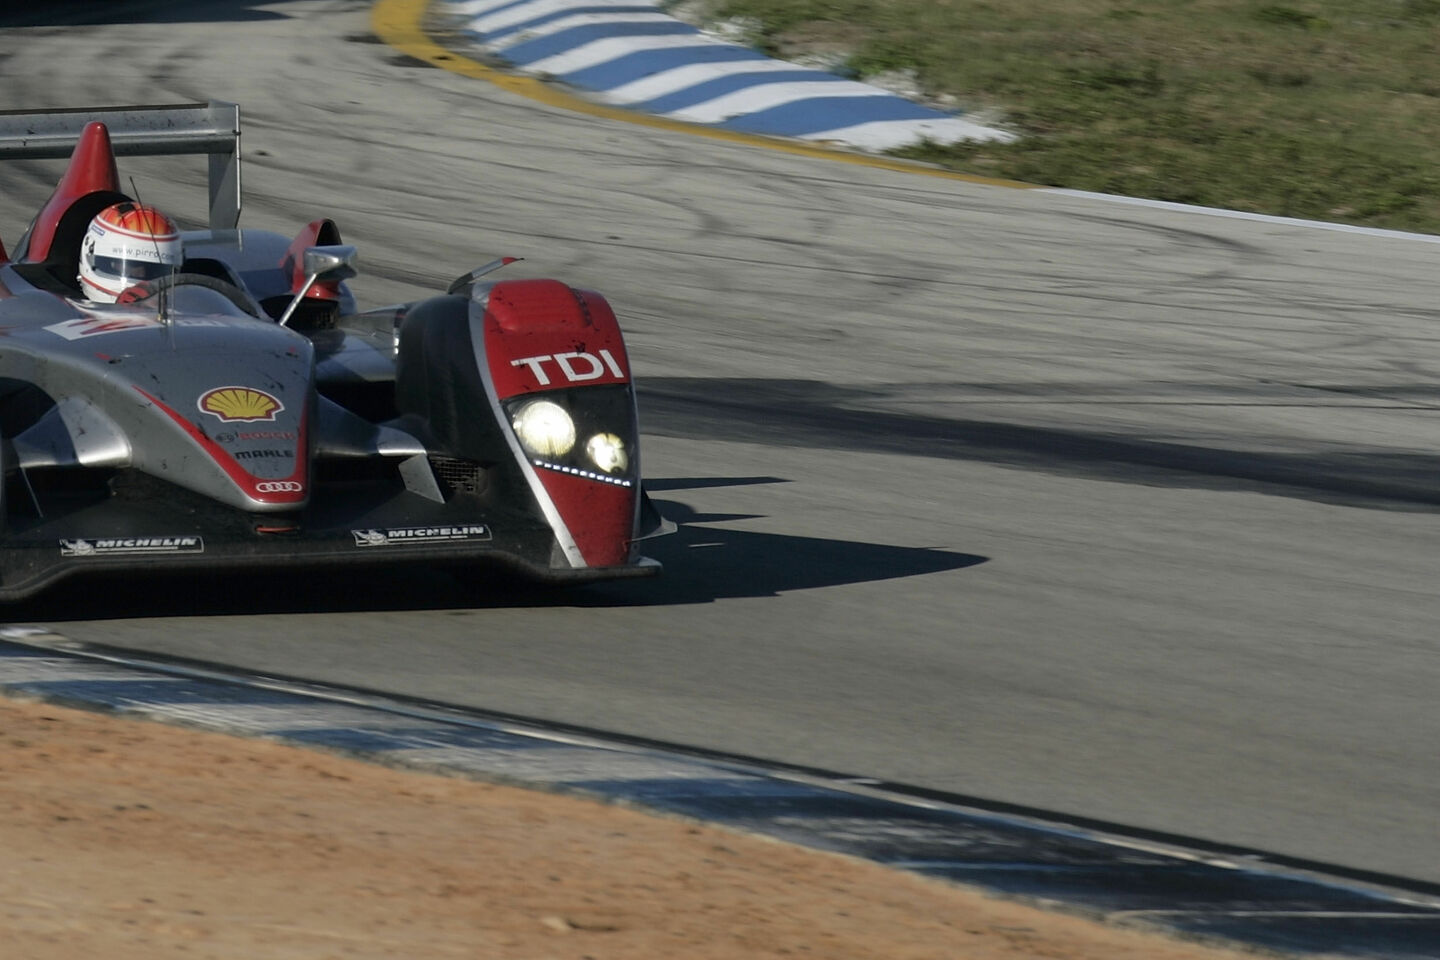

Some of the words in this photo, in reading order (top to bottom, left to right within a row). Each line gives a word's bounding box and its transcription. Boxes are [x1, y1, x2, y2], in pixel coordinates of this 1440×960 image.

[510, 349, 624, 385] TDI
[234, 449, 294, 459] MAHLE
[388, 526, 484, 538] MICHELIN
[96, 538, 197, 548] MICHELIN
